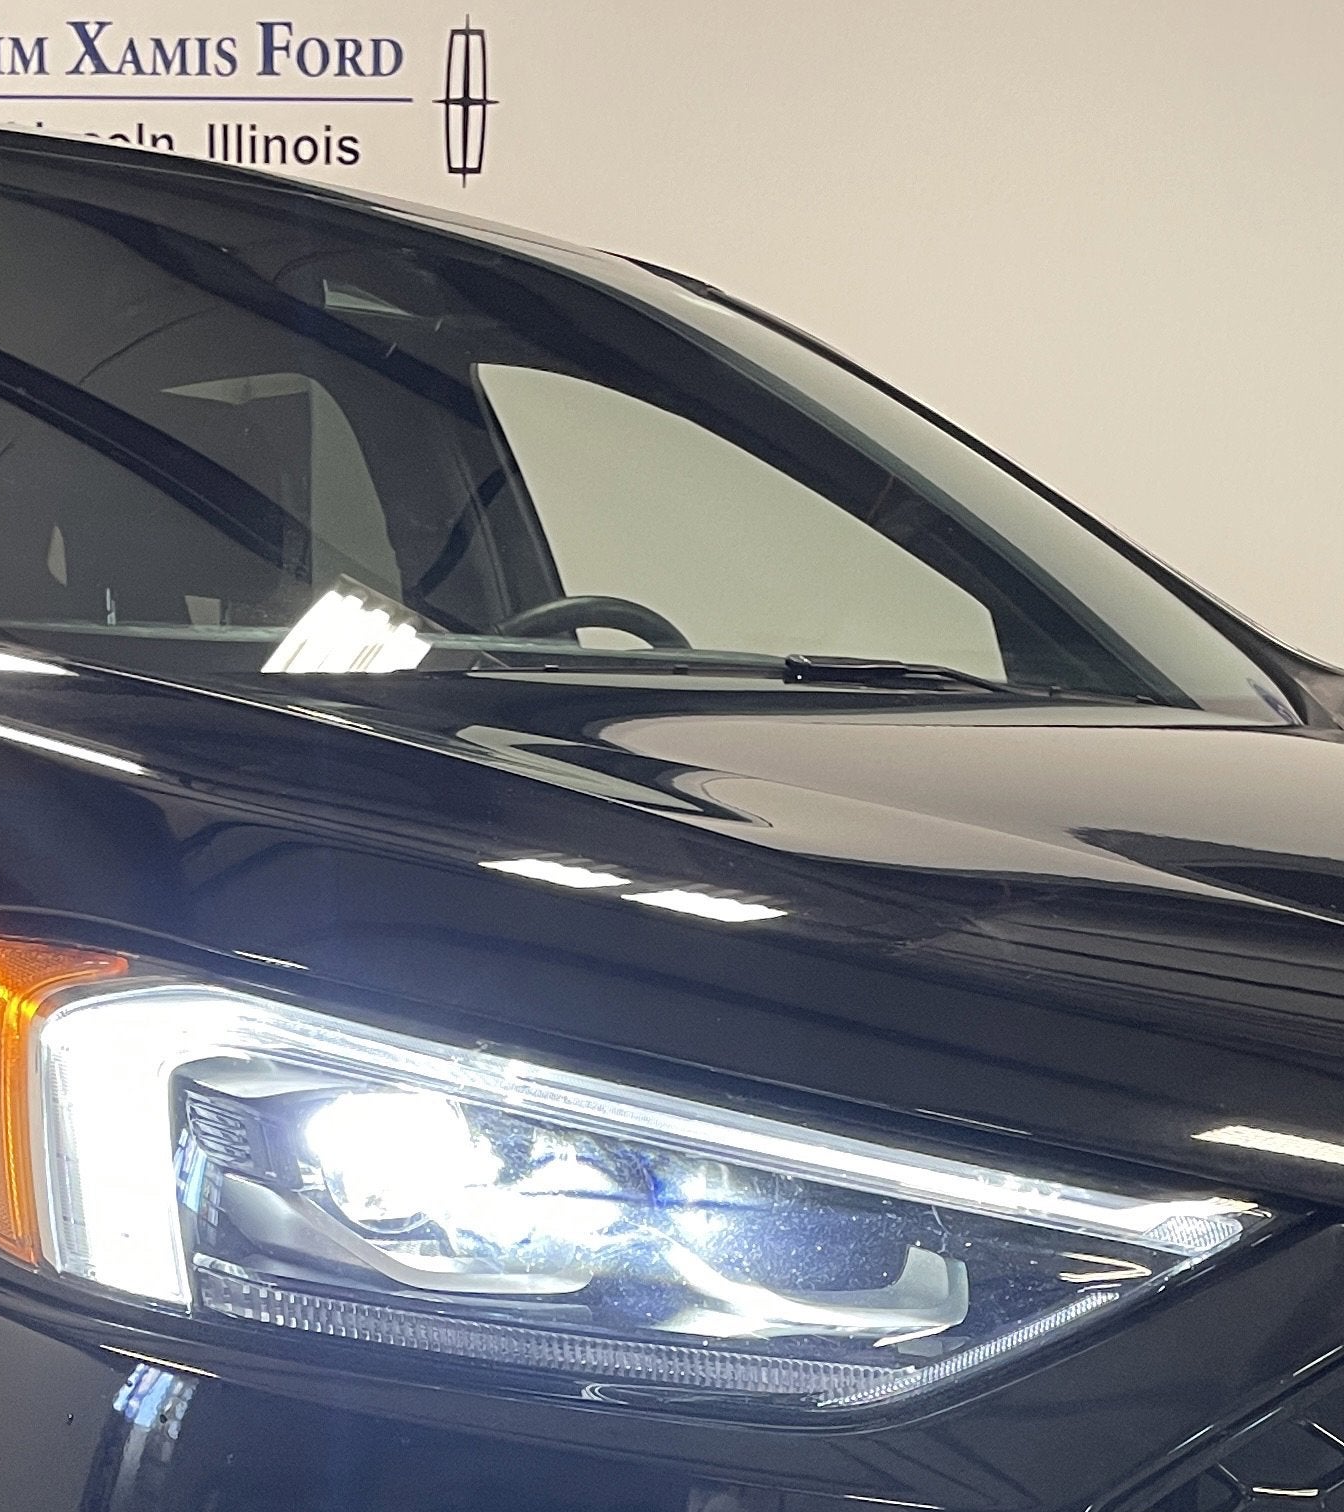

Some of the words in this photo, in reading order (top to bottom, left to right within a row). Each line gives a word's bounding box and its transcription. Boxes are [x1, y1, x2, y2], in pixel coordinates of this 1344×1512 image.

[66, 20, 238, 77] XAMIS
[256, 20, 404, 78] FORD
[208, 123, 361, 166] Illinois
